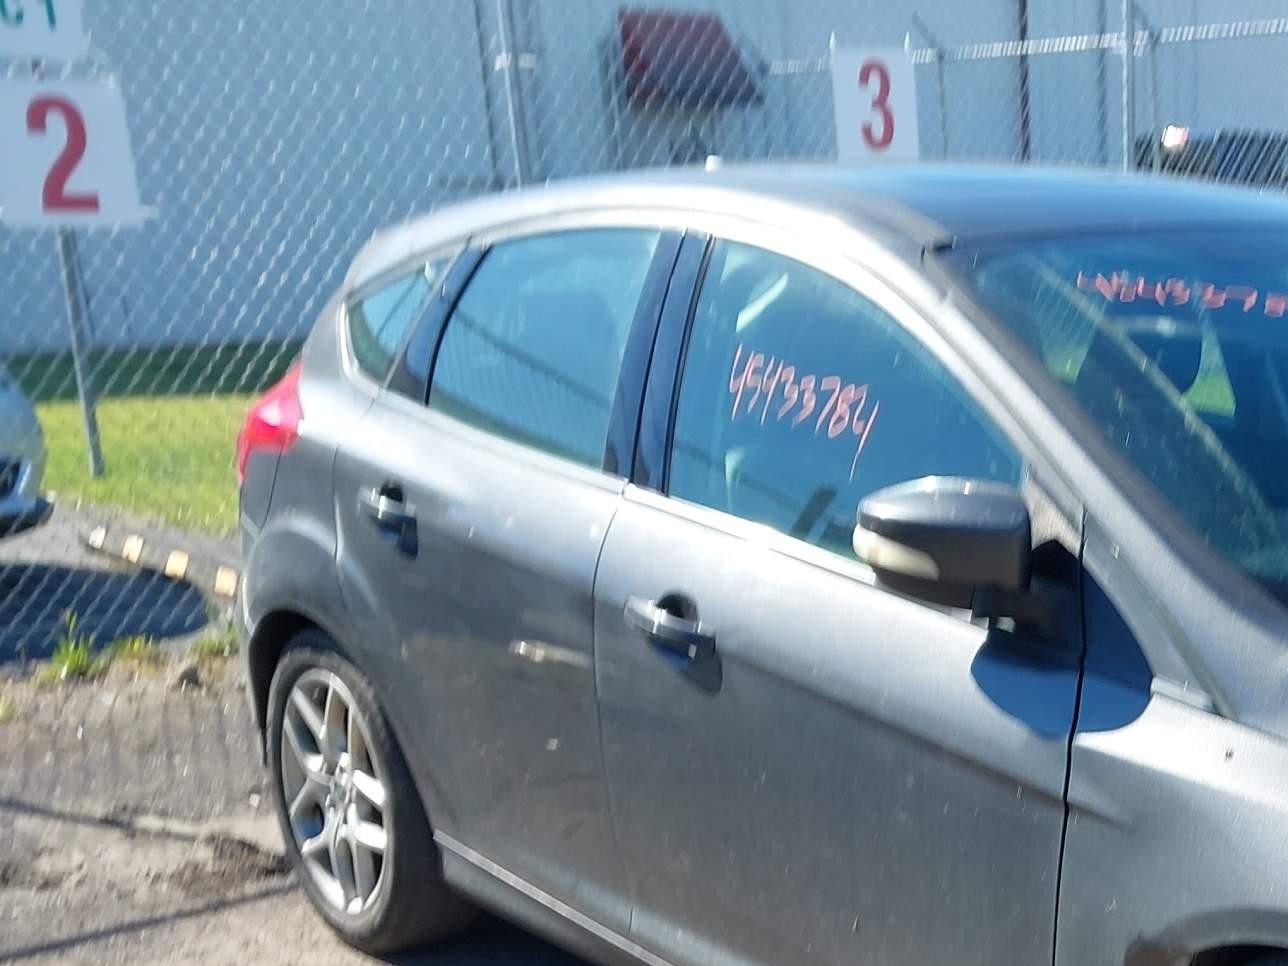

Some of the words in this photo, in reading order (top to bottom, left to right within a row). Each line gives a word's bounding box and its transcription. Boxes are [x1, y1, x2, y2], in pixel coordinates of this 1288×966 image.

[26, 94, 99, 213] 2
[858, 58, 894, 151] 3
[729, 342, 880, 482] 45433784
